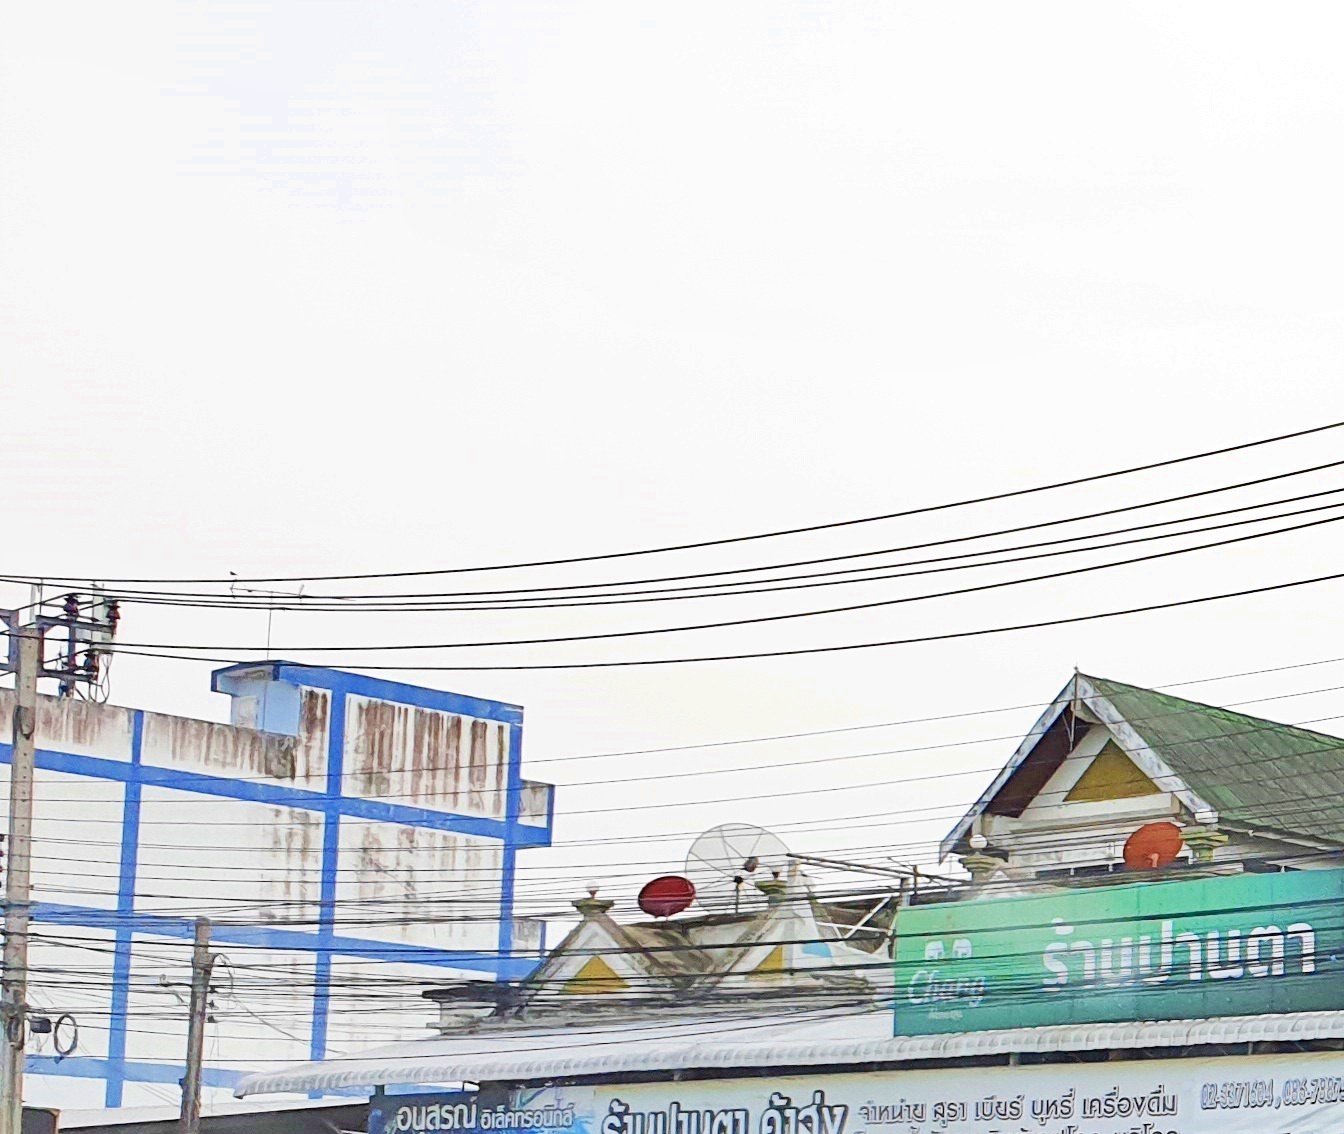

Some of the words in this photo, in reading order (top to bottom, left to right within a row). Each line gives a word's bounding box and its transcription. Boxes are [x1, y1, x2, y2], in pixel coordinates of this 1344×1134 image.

[1042, 917, 1316, 991] ร้านปานตา
[858, 1099, 926, 1125] จำหน่าย
[932, 1100, 967, 1128] สุรา
[975, 1094, 1025, 1121] เบียร์
[1031, 1088, 1075, 1125] บุหรี่
[1082, 1084, 1178, 1118] เครื่องดื่ม
